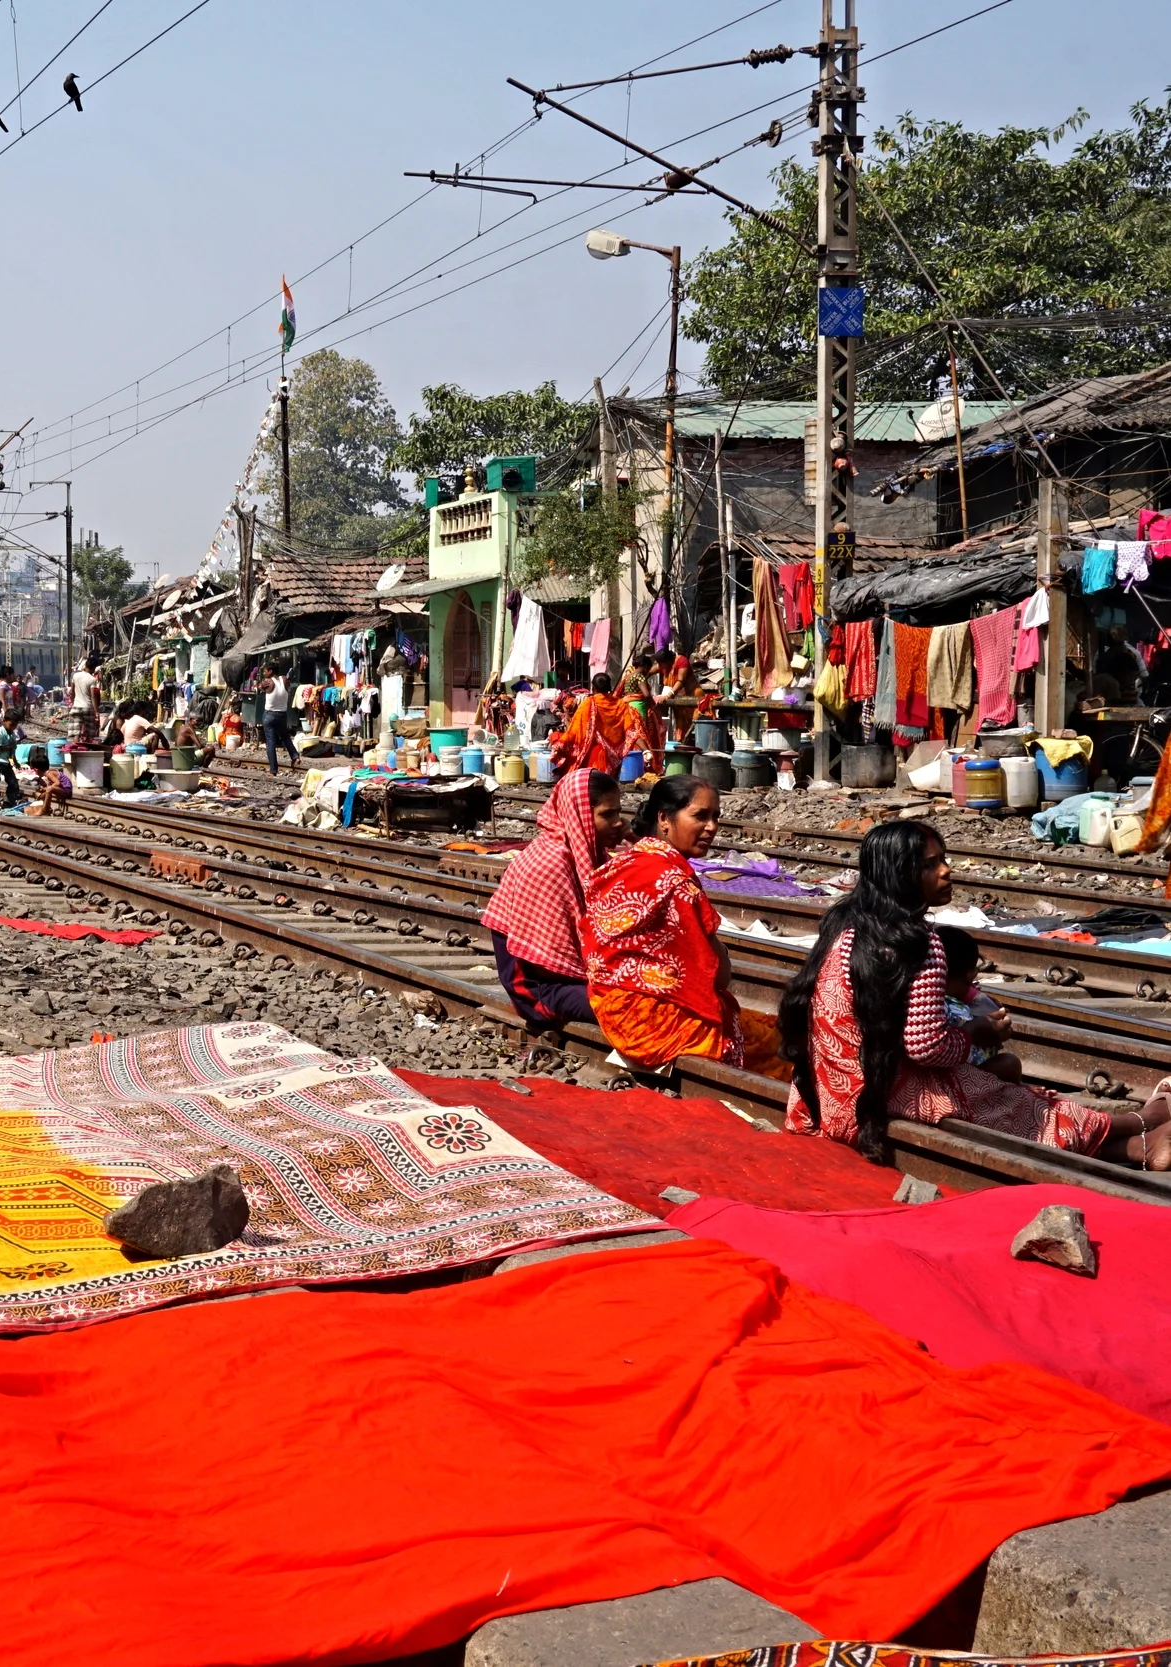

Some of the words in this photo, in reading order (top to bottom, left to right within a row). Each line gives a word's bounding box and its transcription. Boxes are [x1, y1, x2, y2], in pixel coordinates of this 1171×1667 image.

[820, 311, 838, 330] POWER
[842, 288, 859, 306] BLOCK
[825, 289, 848, 314] WORKING
[837, 533, 846, 545] 9
[829, 546, 853, 558] 22X
